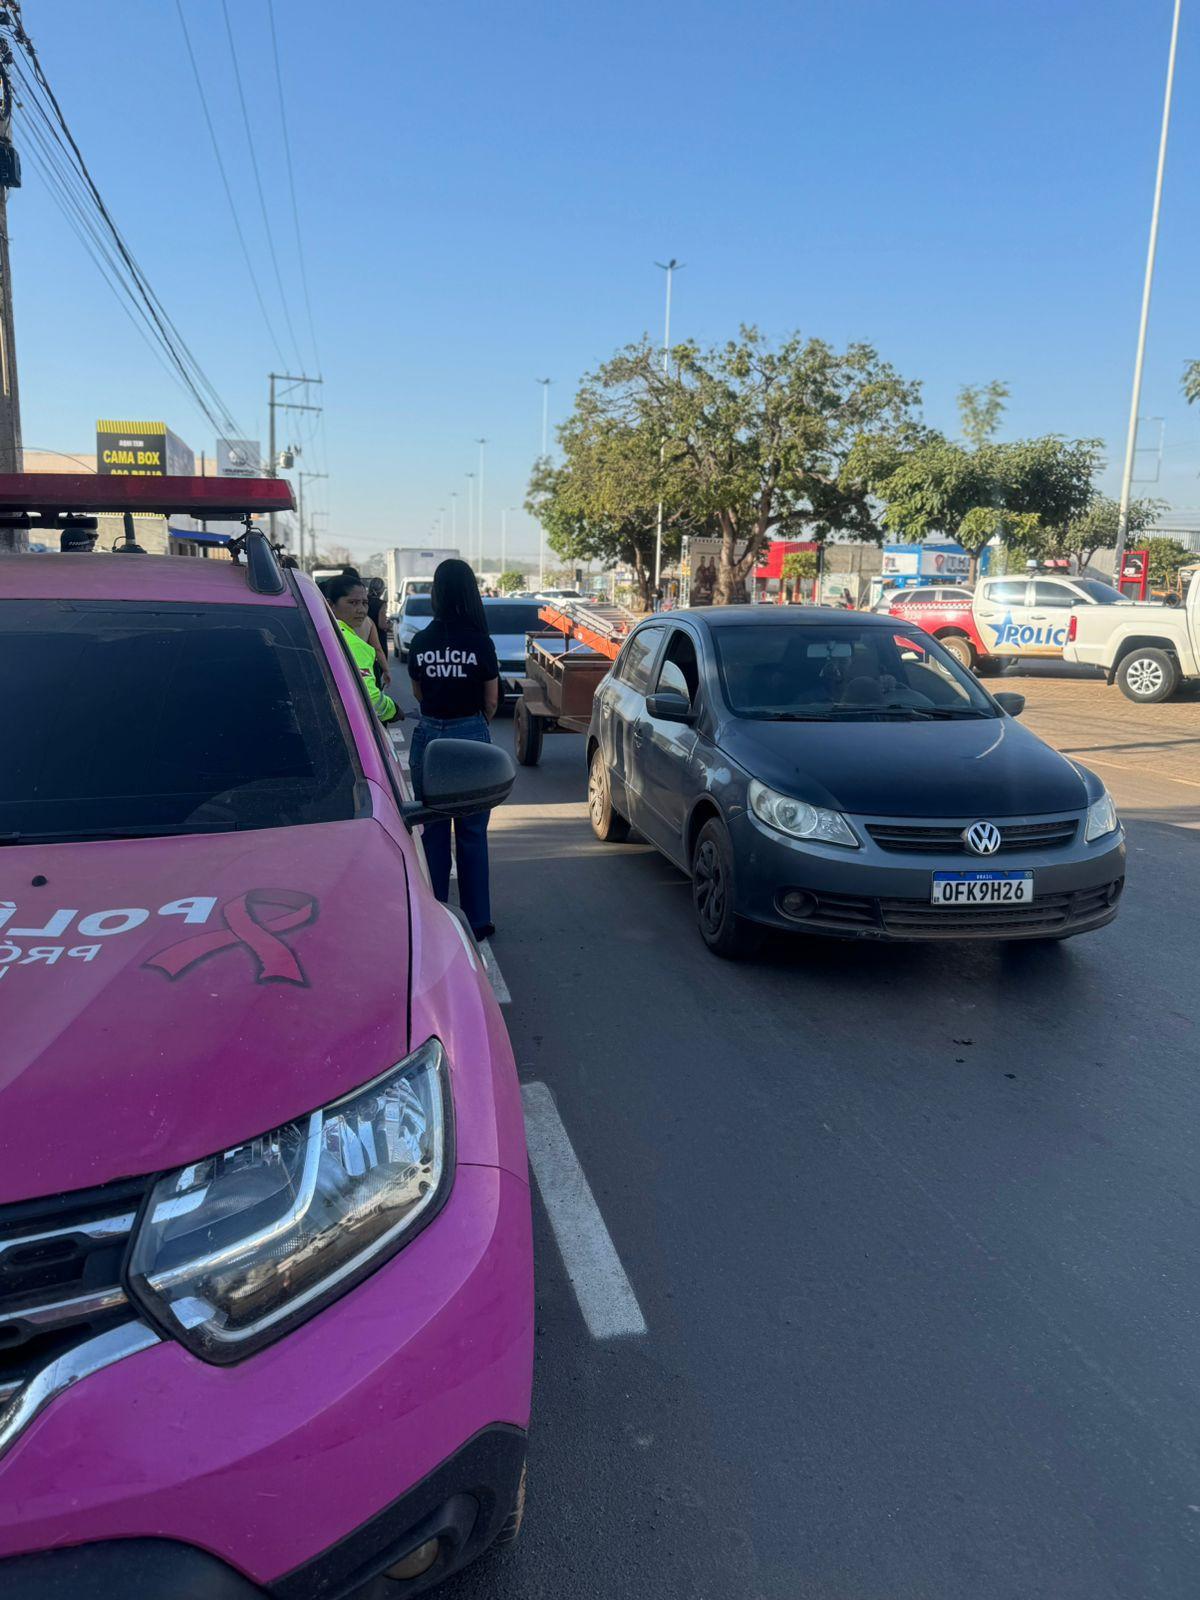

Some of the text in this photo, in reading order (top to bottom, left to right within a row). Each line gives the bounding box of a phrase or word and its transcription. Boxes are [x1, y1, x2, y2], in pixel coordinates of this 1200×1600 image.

[103, 449, 160, 465] CAMA BOX
[416, 647, 478, 666] POLÍCIA
[425, 665, 467, 678] CIVIL
[942, 881, 1024, 901] OFK9H26
